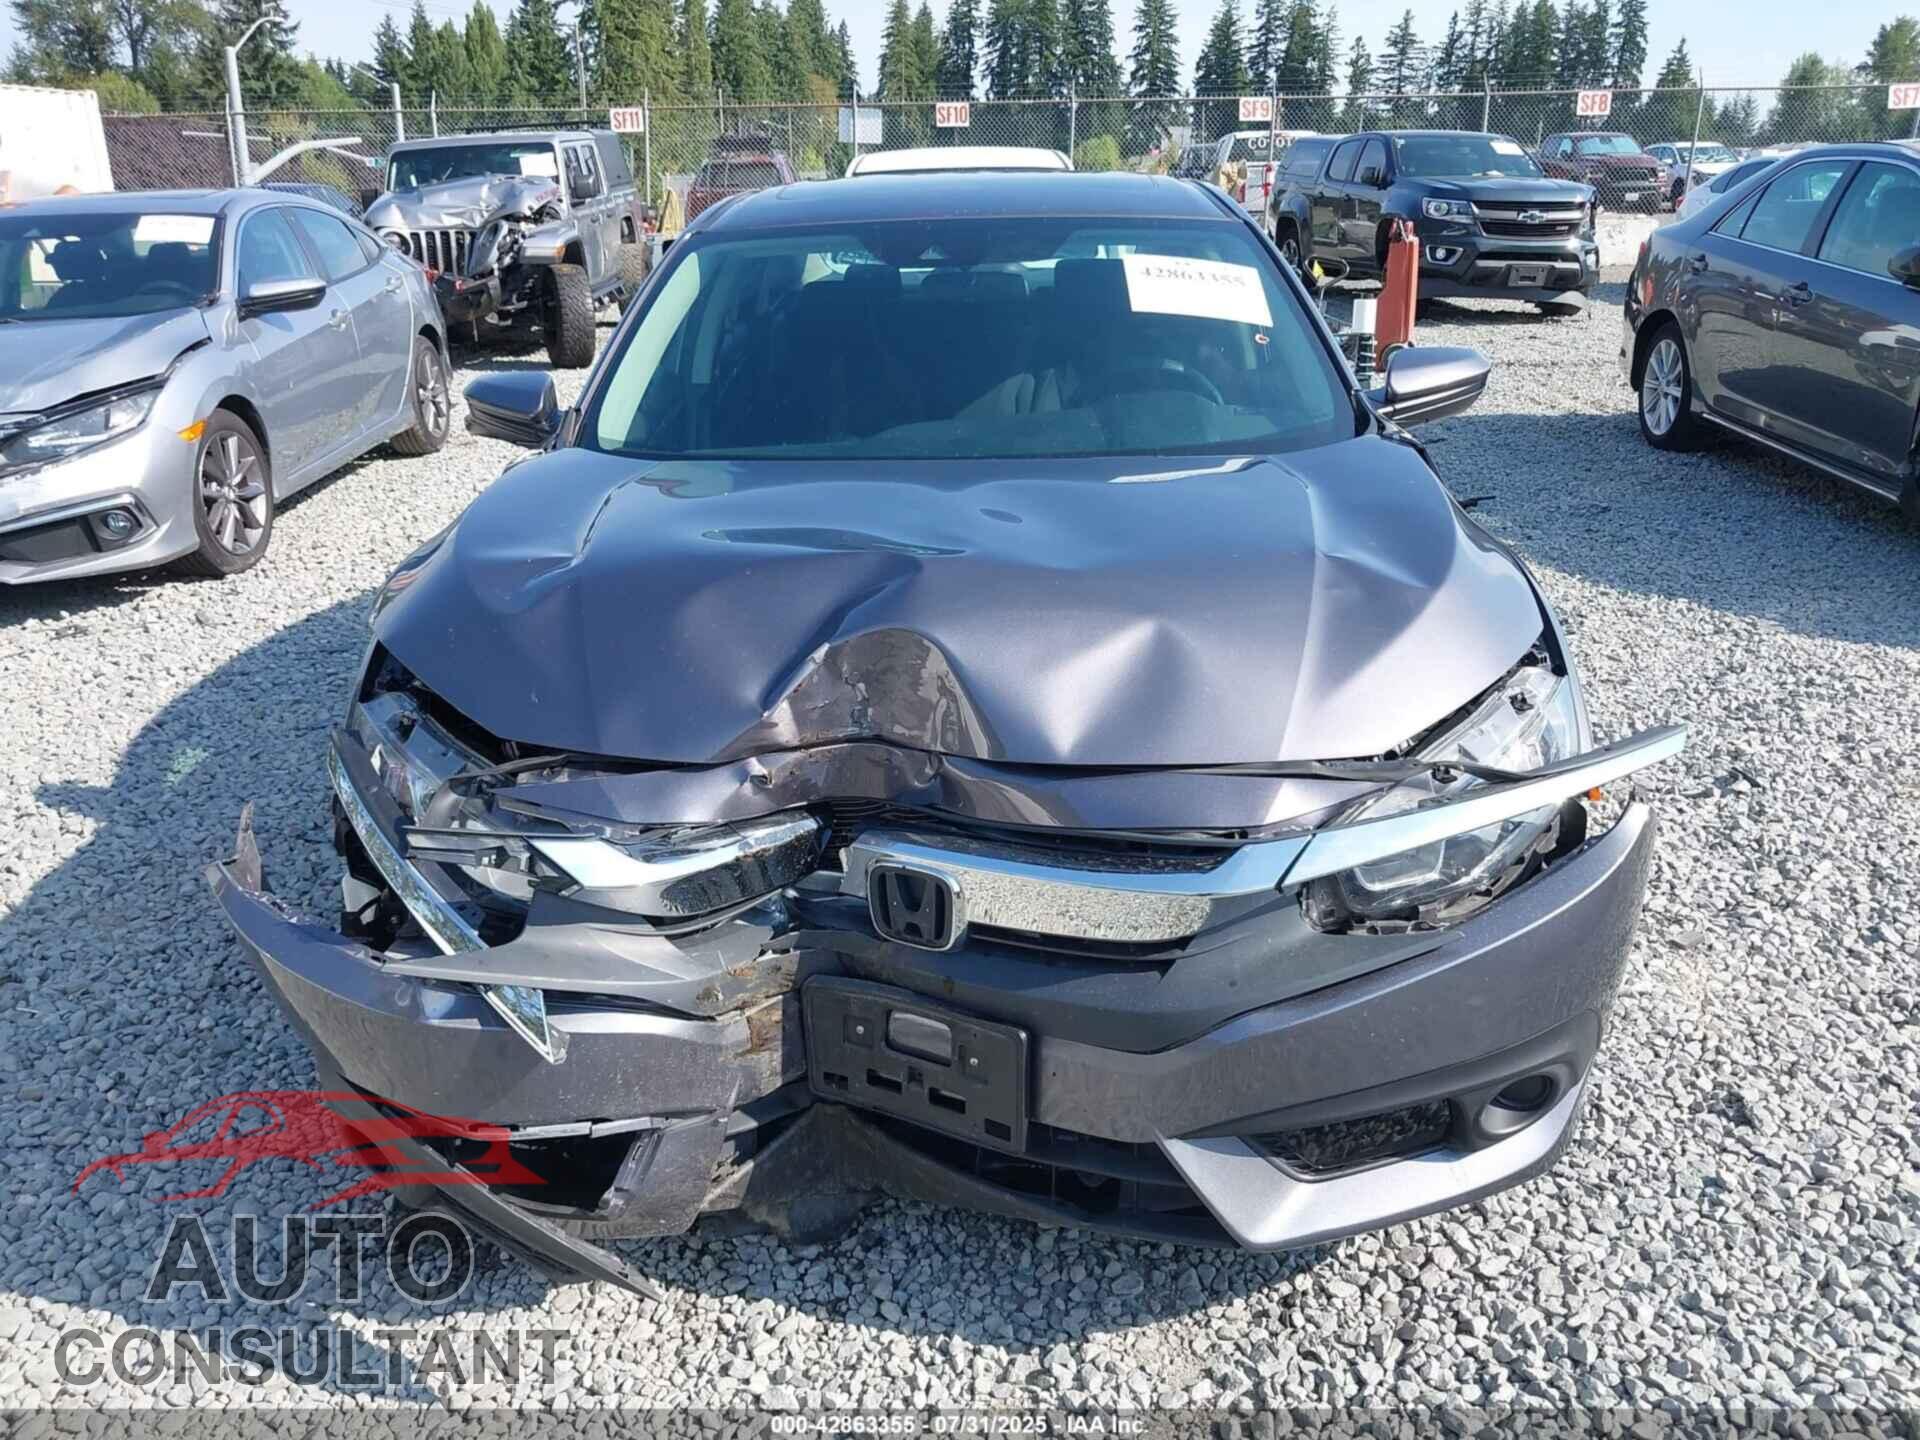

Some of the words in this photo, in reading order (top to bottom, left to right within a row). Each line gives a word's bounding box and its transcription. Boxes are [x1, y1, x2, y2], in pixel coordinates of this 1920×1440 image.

[1580, 94, 1608, 113] SF8
[1893, 87, 1919, 106] SF7
[938, 105, 968, 124] SF10
[1242, 100, 1270, 118] SF9
[612, 111, 640, 129] SF11
[1247, 136, 1294, 150] COOT
